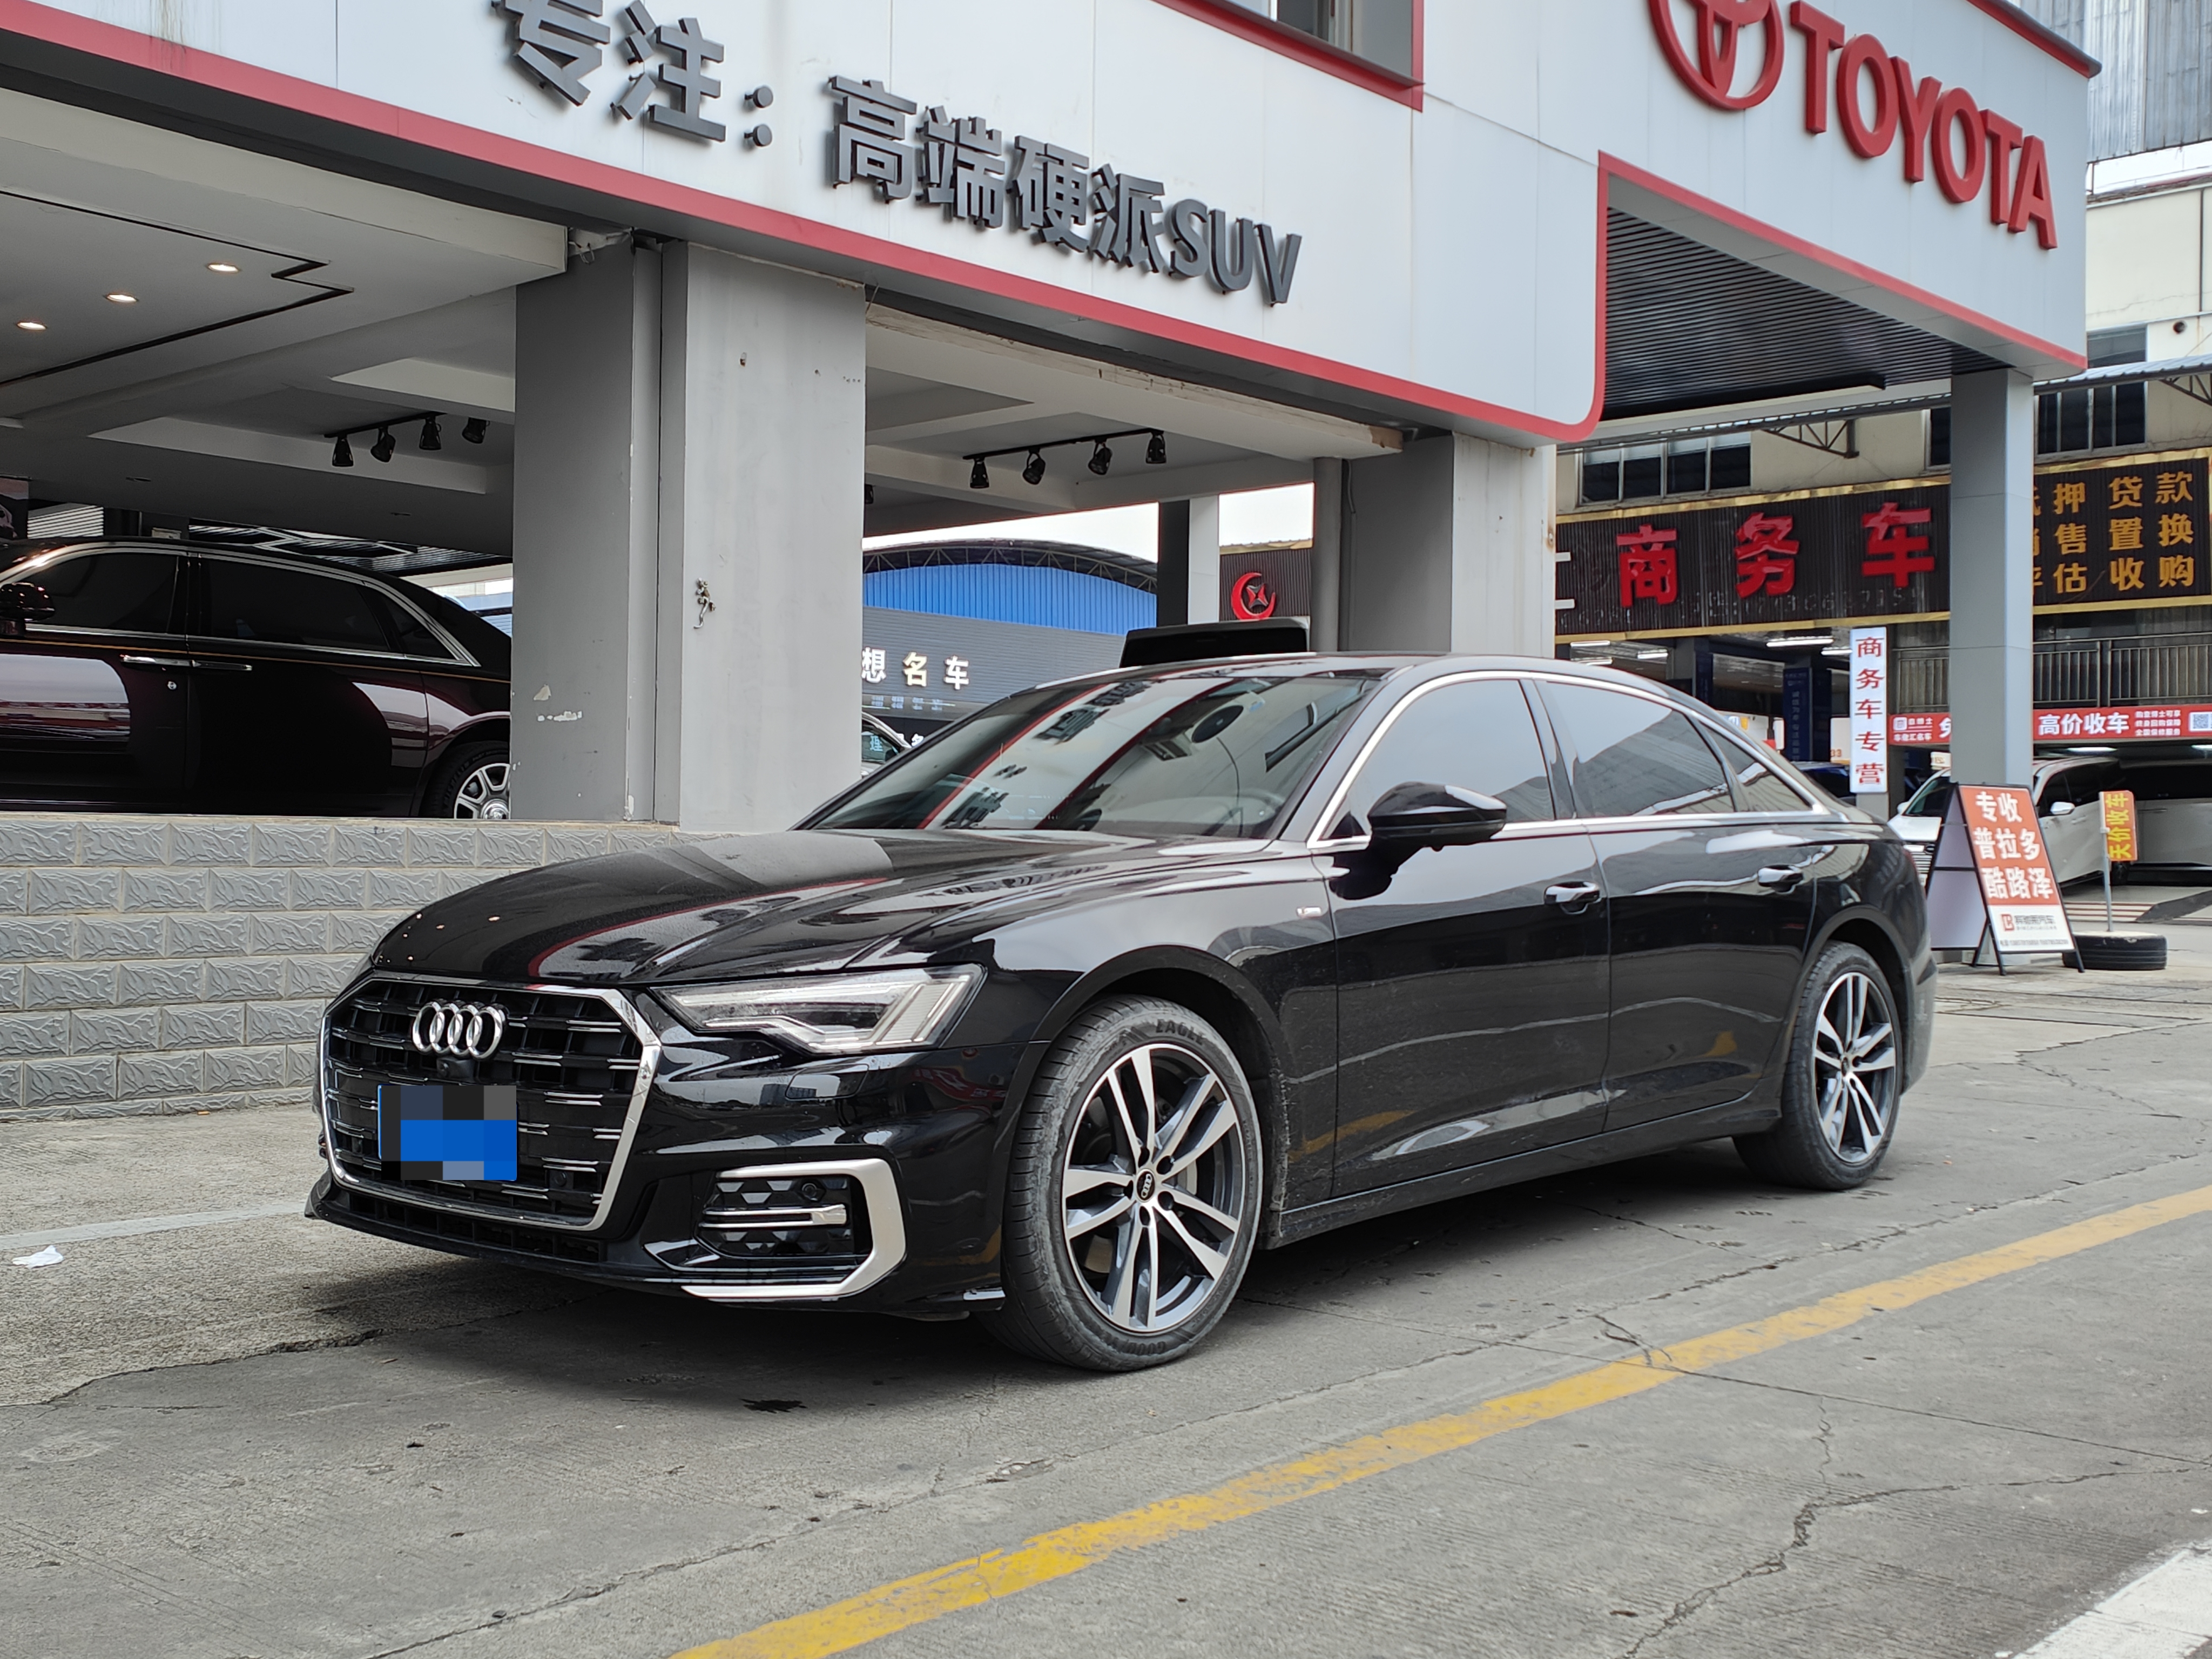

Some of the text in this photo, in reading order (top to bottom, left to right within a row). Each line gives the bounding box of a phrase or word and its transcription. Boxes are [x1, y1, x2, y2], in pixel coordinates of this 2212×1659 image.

[1790, 1, 2058, 250] TOYOTA
[1616, 502, 1935, 607] 商务车
[1854, 637, 1885, 784] 商务车专营
[2038, 712, 2129, 736] 高价收车
[1975, 791, 2022, 822] 专收
[2105, 792, 2132, 859] 天价收车
[1973, 827, 2040, 861] 普拉多
[1981, 866, 2054, 899] 酷路泽
